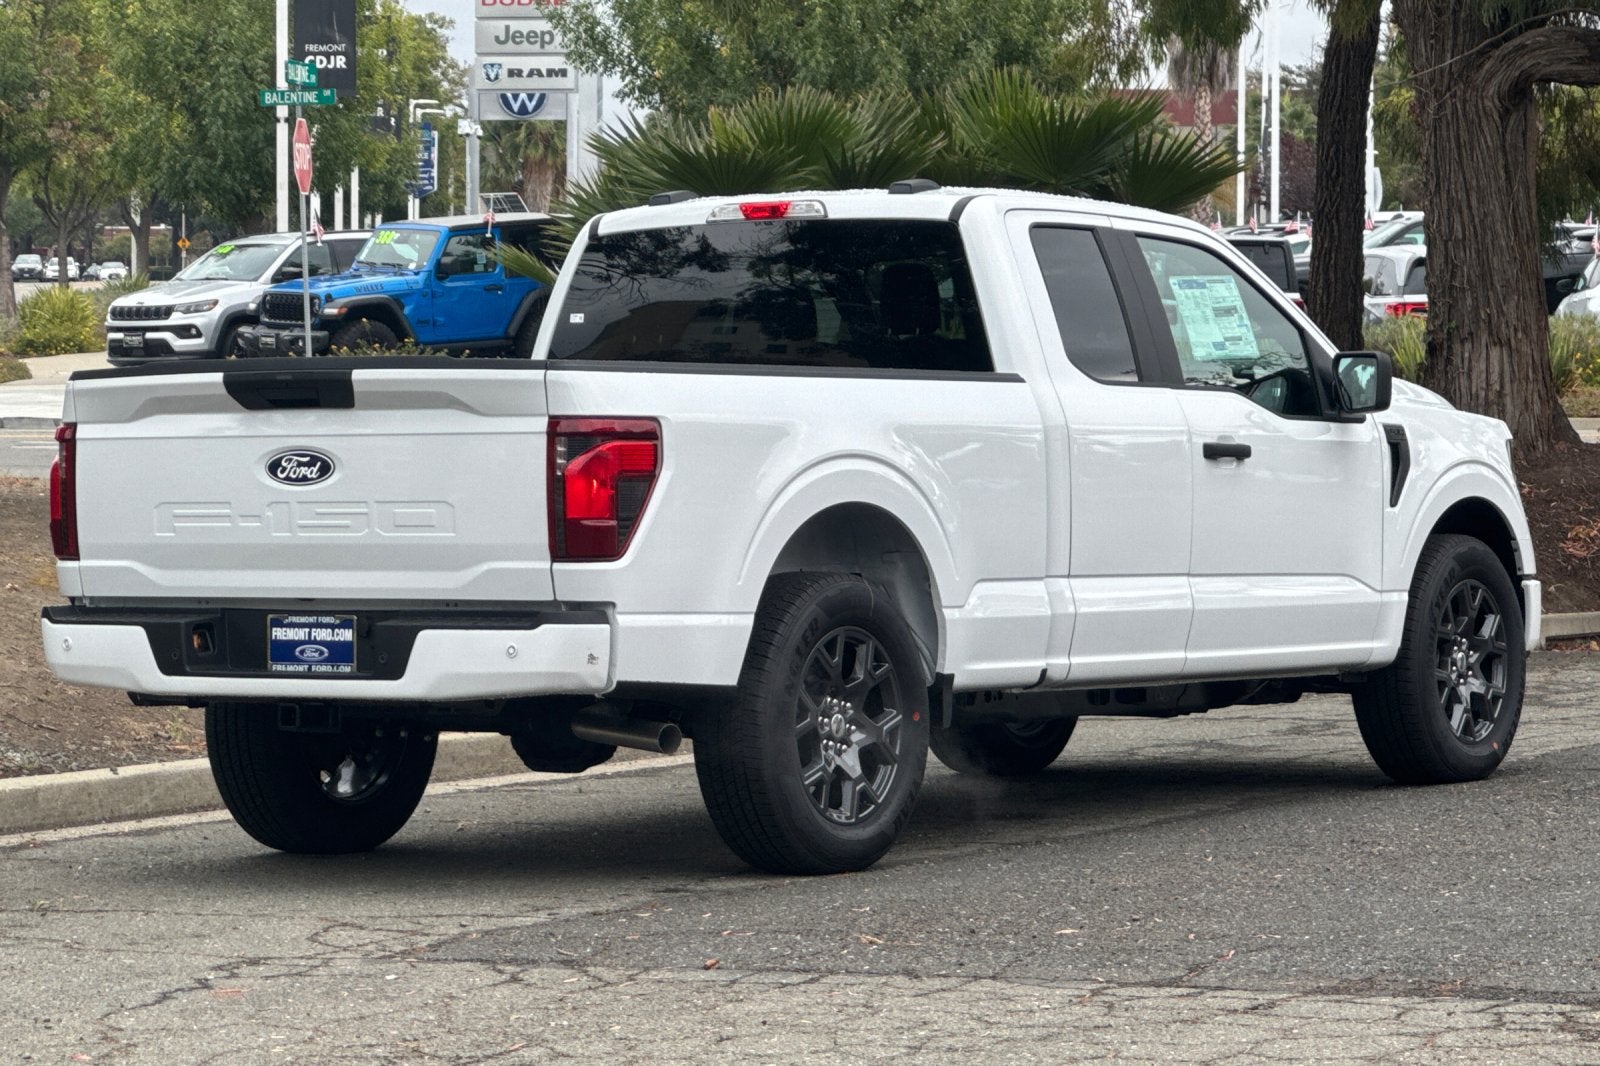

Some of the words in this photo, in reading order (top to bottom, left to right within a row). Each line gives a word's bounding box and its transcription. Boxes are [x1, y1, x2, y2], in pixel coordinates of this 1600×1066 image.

[494, 24, 555, 49] Jeep
[304, 43, 346, 52] FREMONT
[507, 68, 568, 78] RAM
[264, 91, 319, 104] BALENTINE
[295, 142, 311, 170] STOP
[277, 454, 321, 479] Ford
[153, 500, 456, 536] F-150
[271, 627, 310, 640] FREMONT
[311, 628, 353, 641] FORD.COM
[303, 647, 320, 658] Ford
[271, 664, 309, 673] FREMONT
